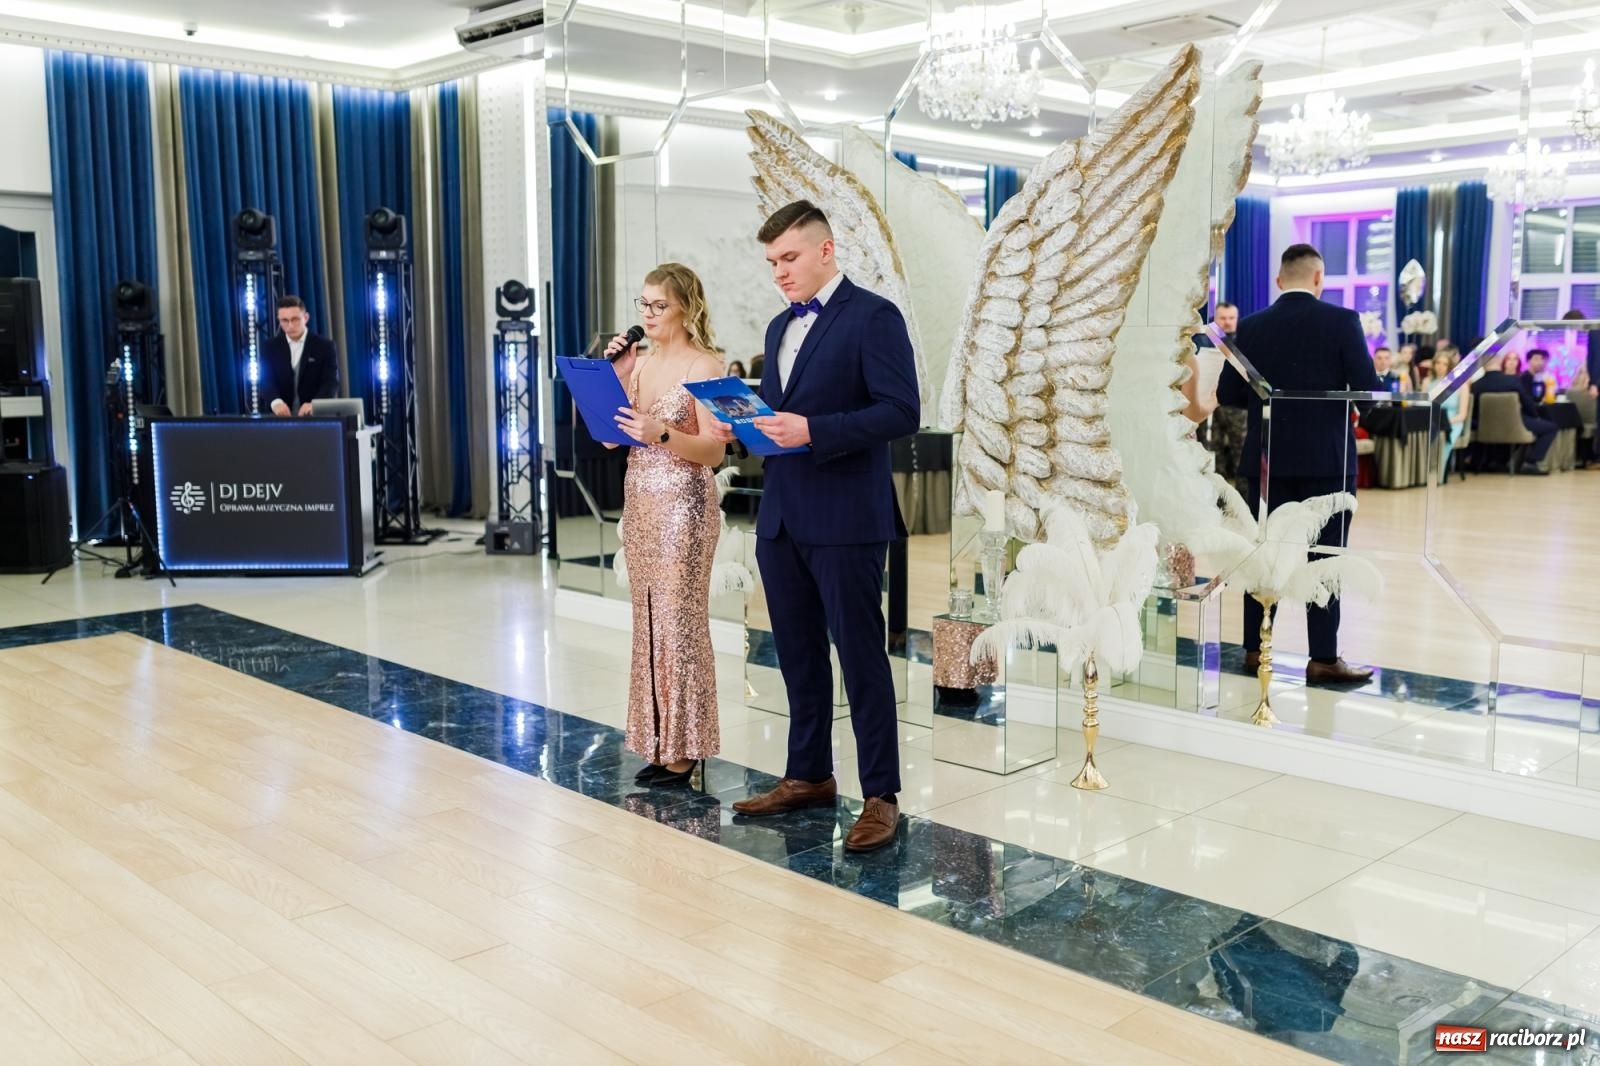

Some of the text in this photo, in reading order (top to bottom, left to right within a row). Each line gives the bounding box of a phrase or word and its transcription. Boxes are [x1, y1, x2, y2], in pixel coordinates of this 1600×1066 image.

[219, 483, 283, 500] DJ DEJV
[219, 503, 334, 512] OPRAWA MUZYCZNA IMPREZ
